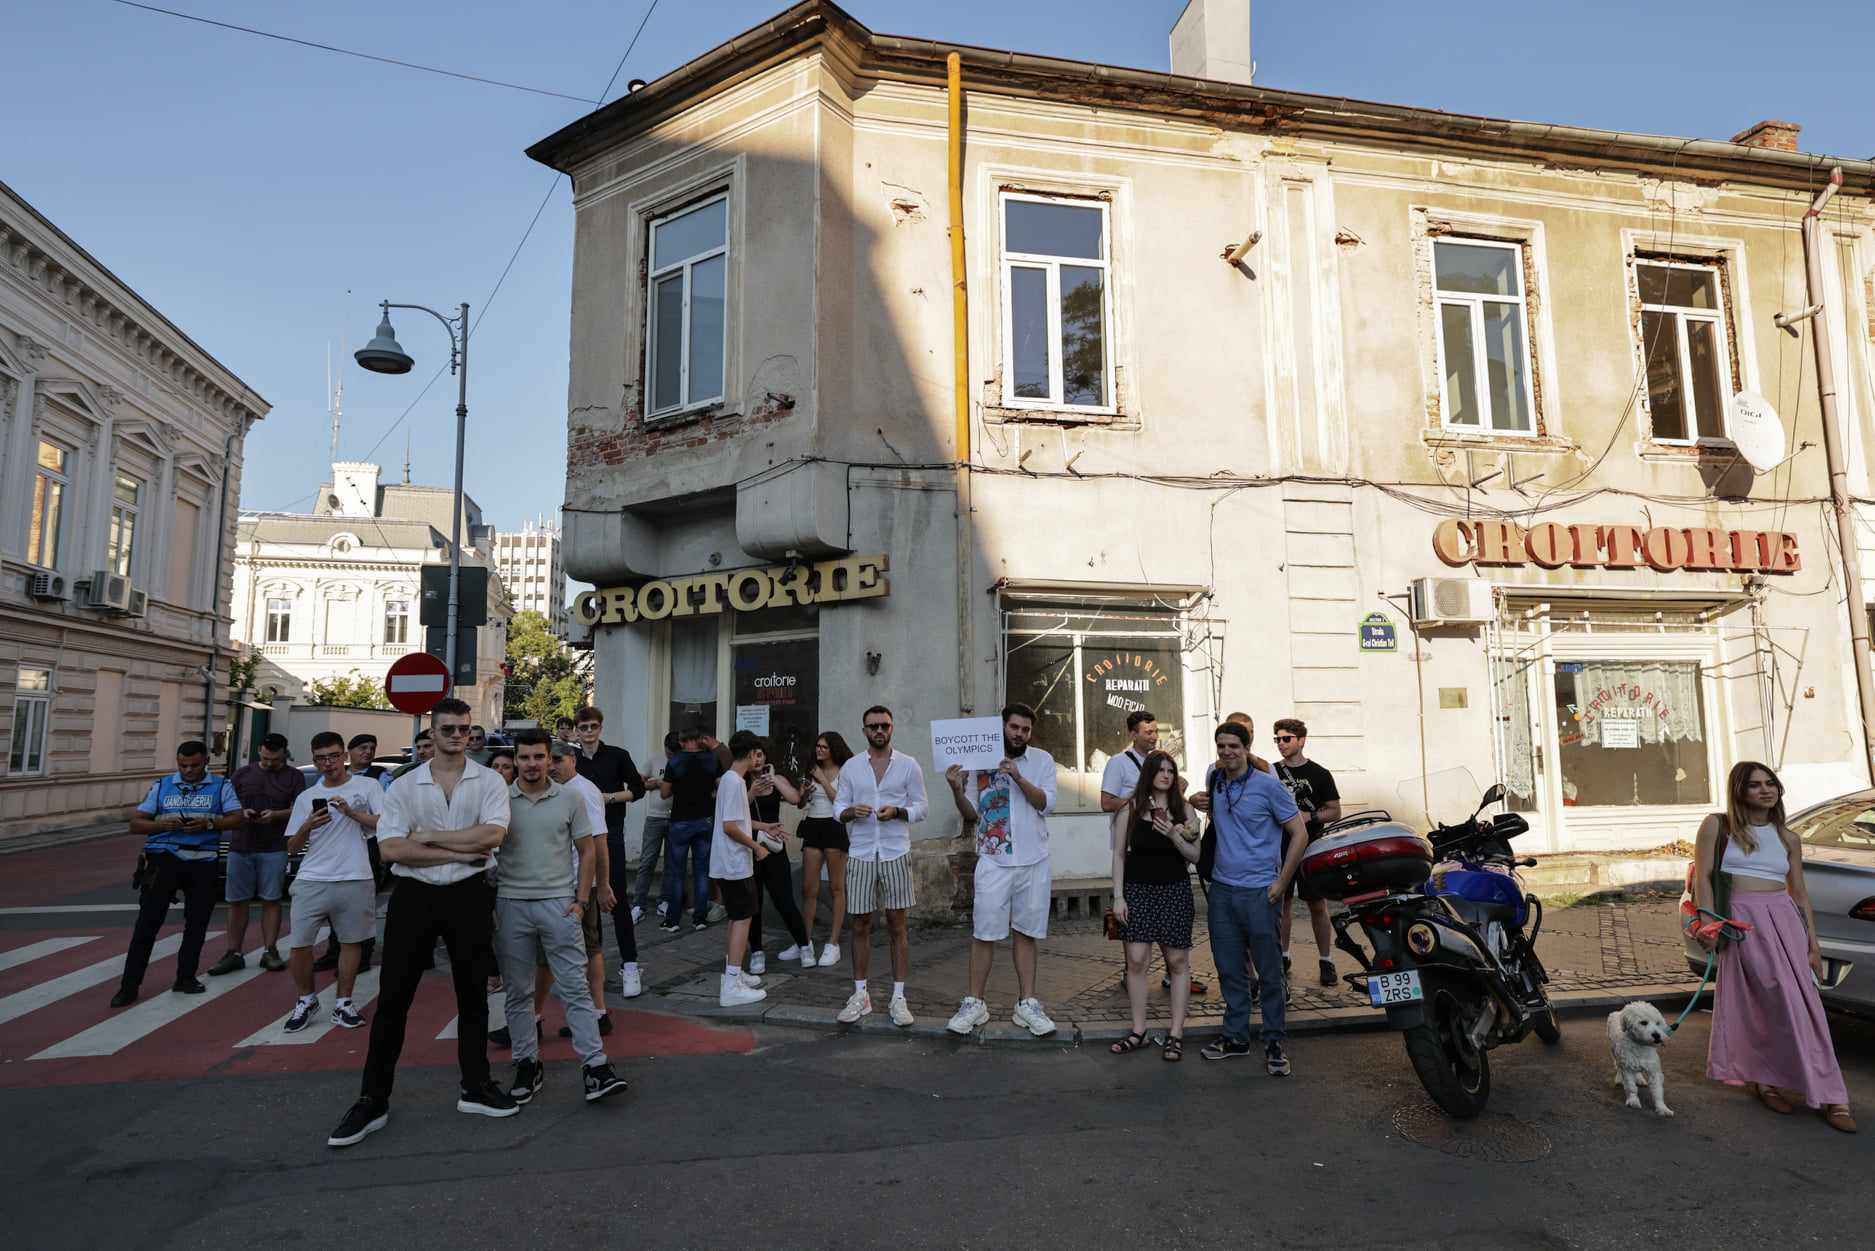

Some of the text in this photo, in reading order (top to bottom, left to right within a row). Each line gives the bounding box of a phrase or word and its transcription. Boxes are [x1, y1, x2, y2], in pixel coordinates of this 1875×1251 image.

[1432, 518, 1802, 576] CROITORIE
[574, 552, 890, 625] CROITORIE
[754, 672, 797, 688] croitorie
[935, 733, 1001, 745] BOYCOTT THE
[945, 744, 993, 755] OLYMPICS
[1380, 973, 1410, 988] B 99
[1384, 987, 1412, 1002] ZRS
